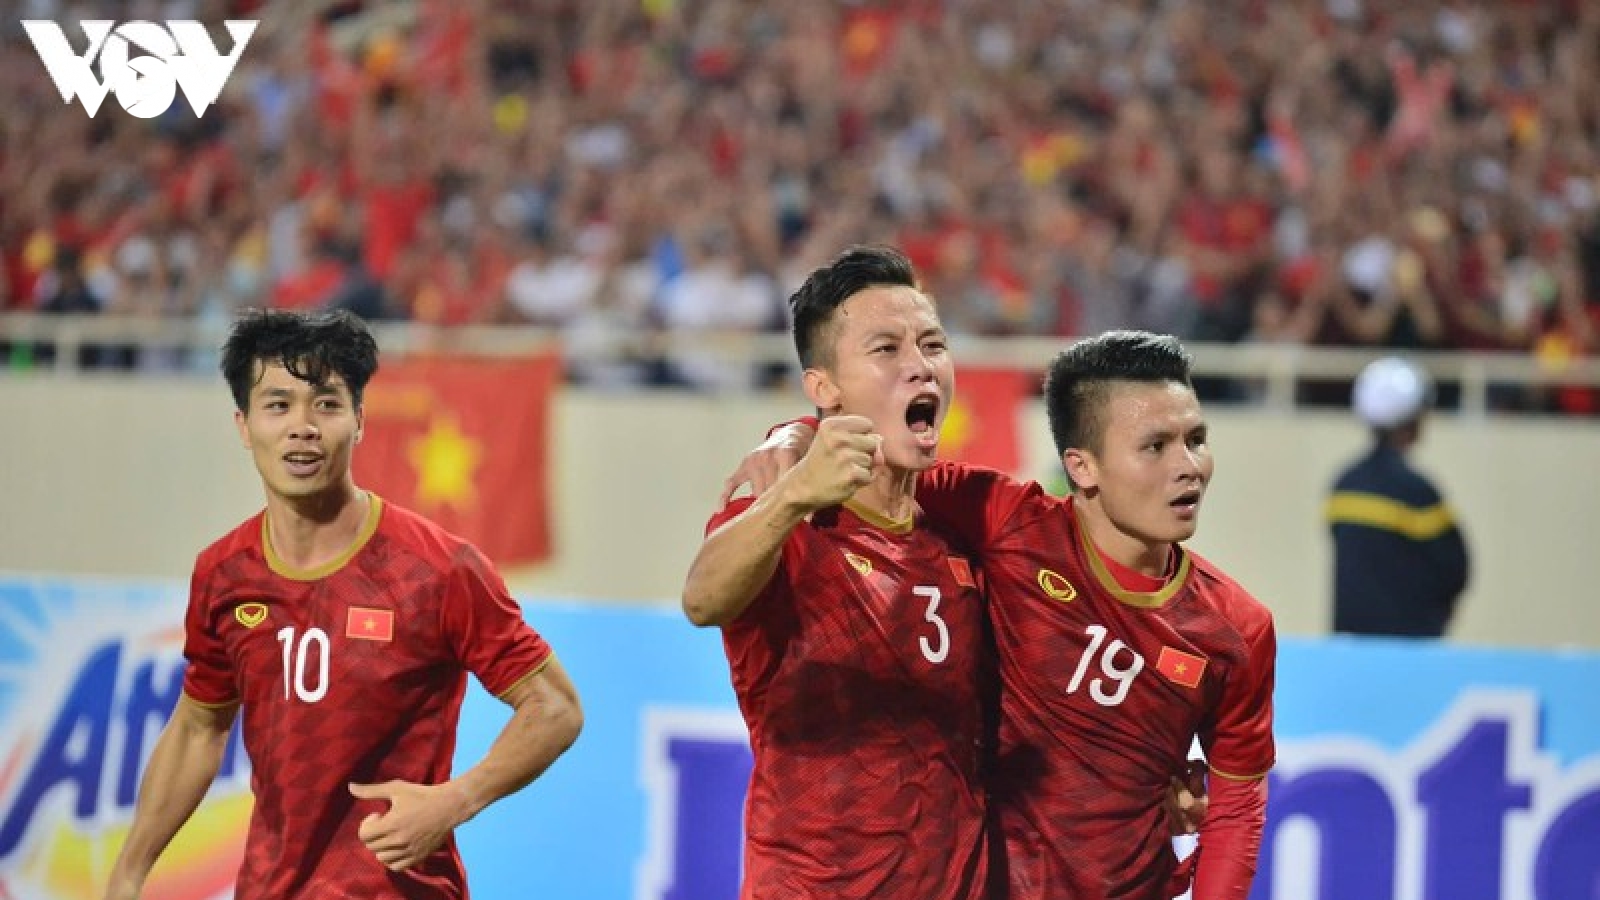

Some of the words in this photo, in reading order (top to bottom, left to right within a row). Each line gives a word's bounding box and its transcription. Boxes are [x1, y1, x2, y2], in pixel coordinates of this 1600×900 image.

[912, 585, 950, 664] 3
[277, 626, 330, 703] 10
[1065, 623, 1146, 707] 19
